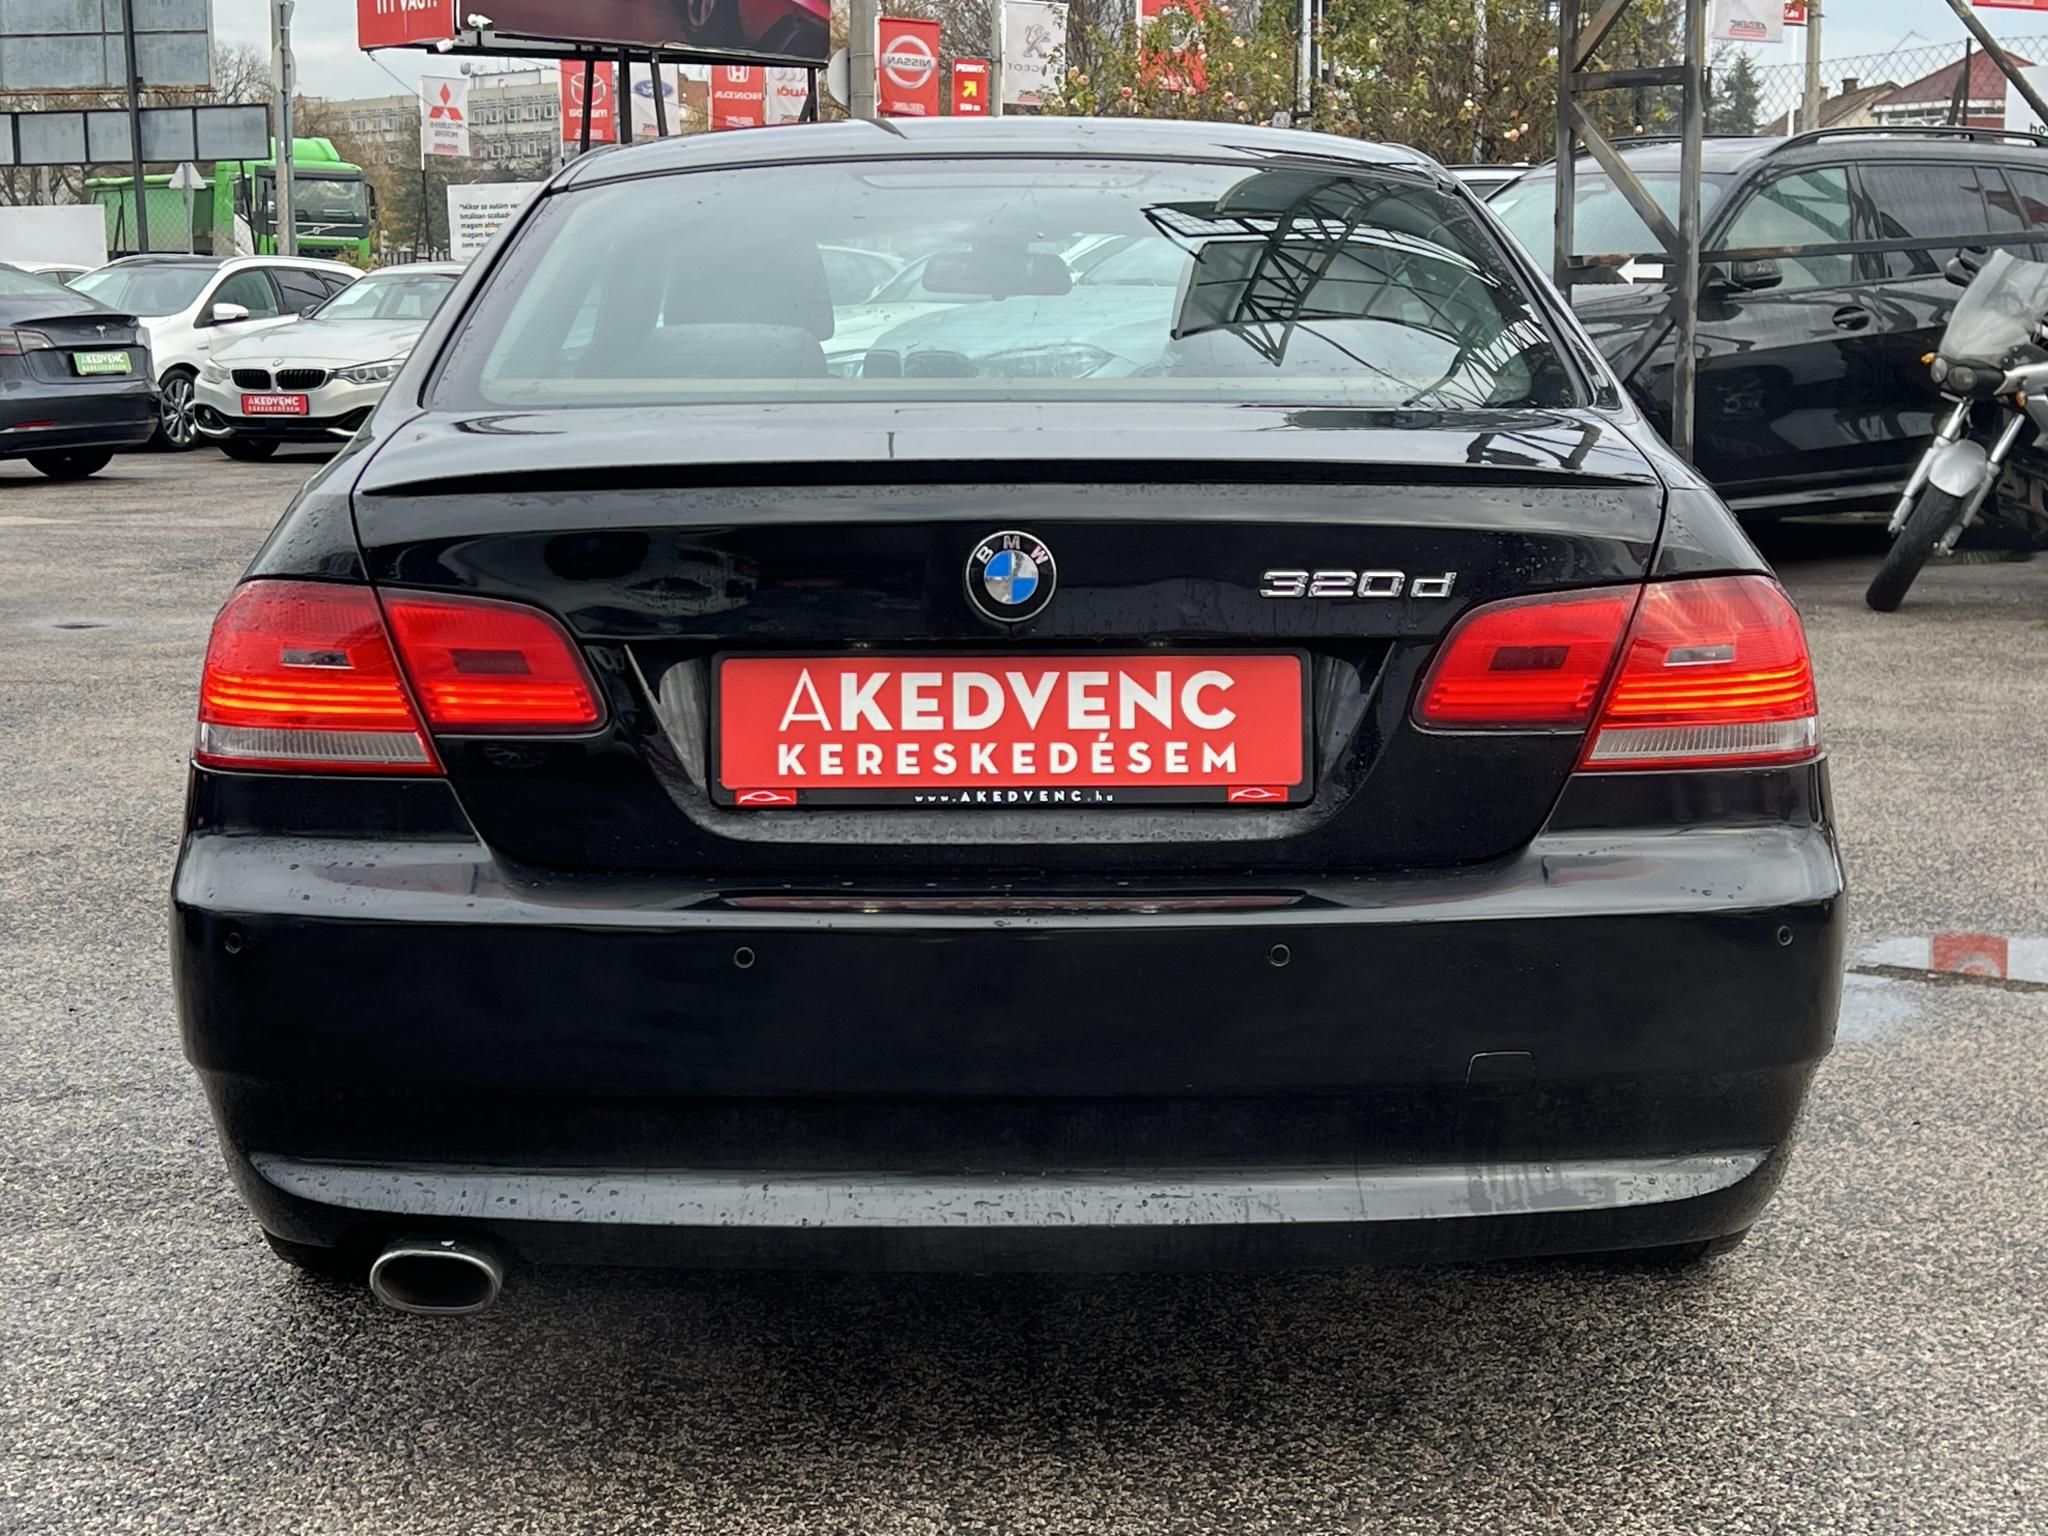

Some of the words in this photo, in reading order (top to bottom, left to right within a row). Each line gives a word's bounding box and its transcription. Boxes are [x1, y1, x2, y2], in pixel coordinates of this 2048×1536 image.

[249, 396, 299, 406] AKEDVENC
[976, 535, 1049, 565] BMW
[778, 668, 1237, 731] AKEDVENC
[778, 734, 1237, 775] KERESKEDÉSEM
[915, 790, 1114, 802] www.AKEDVENC.hu
